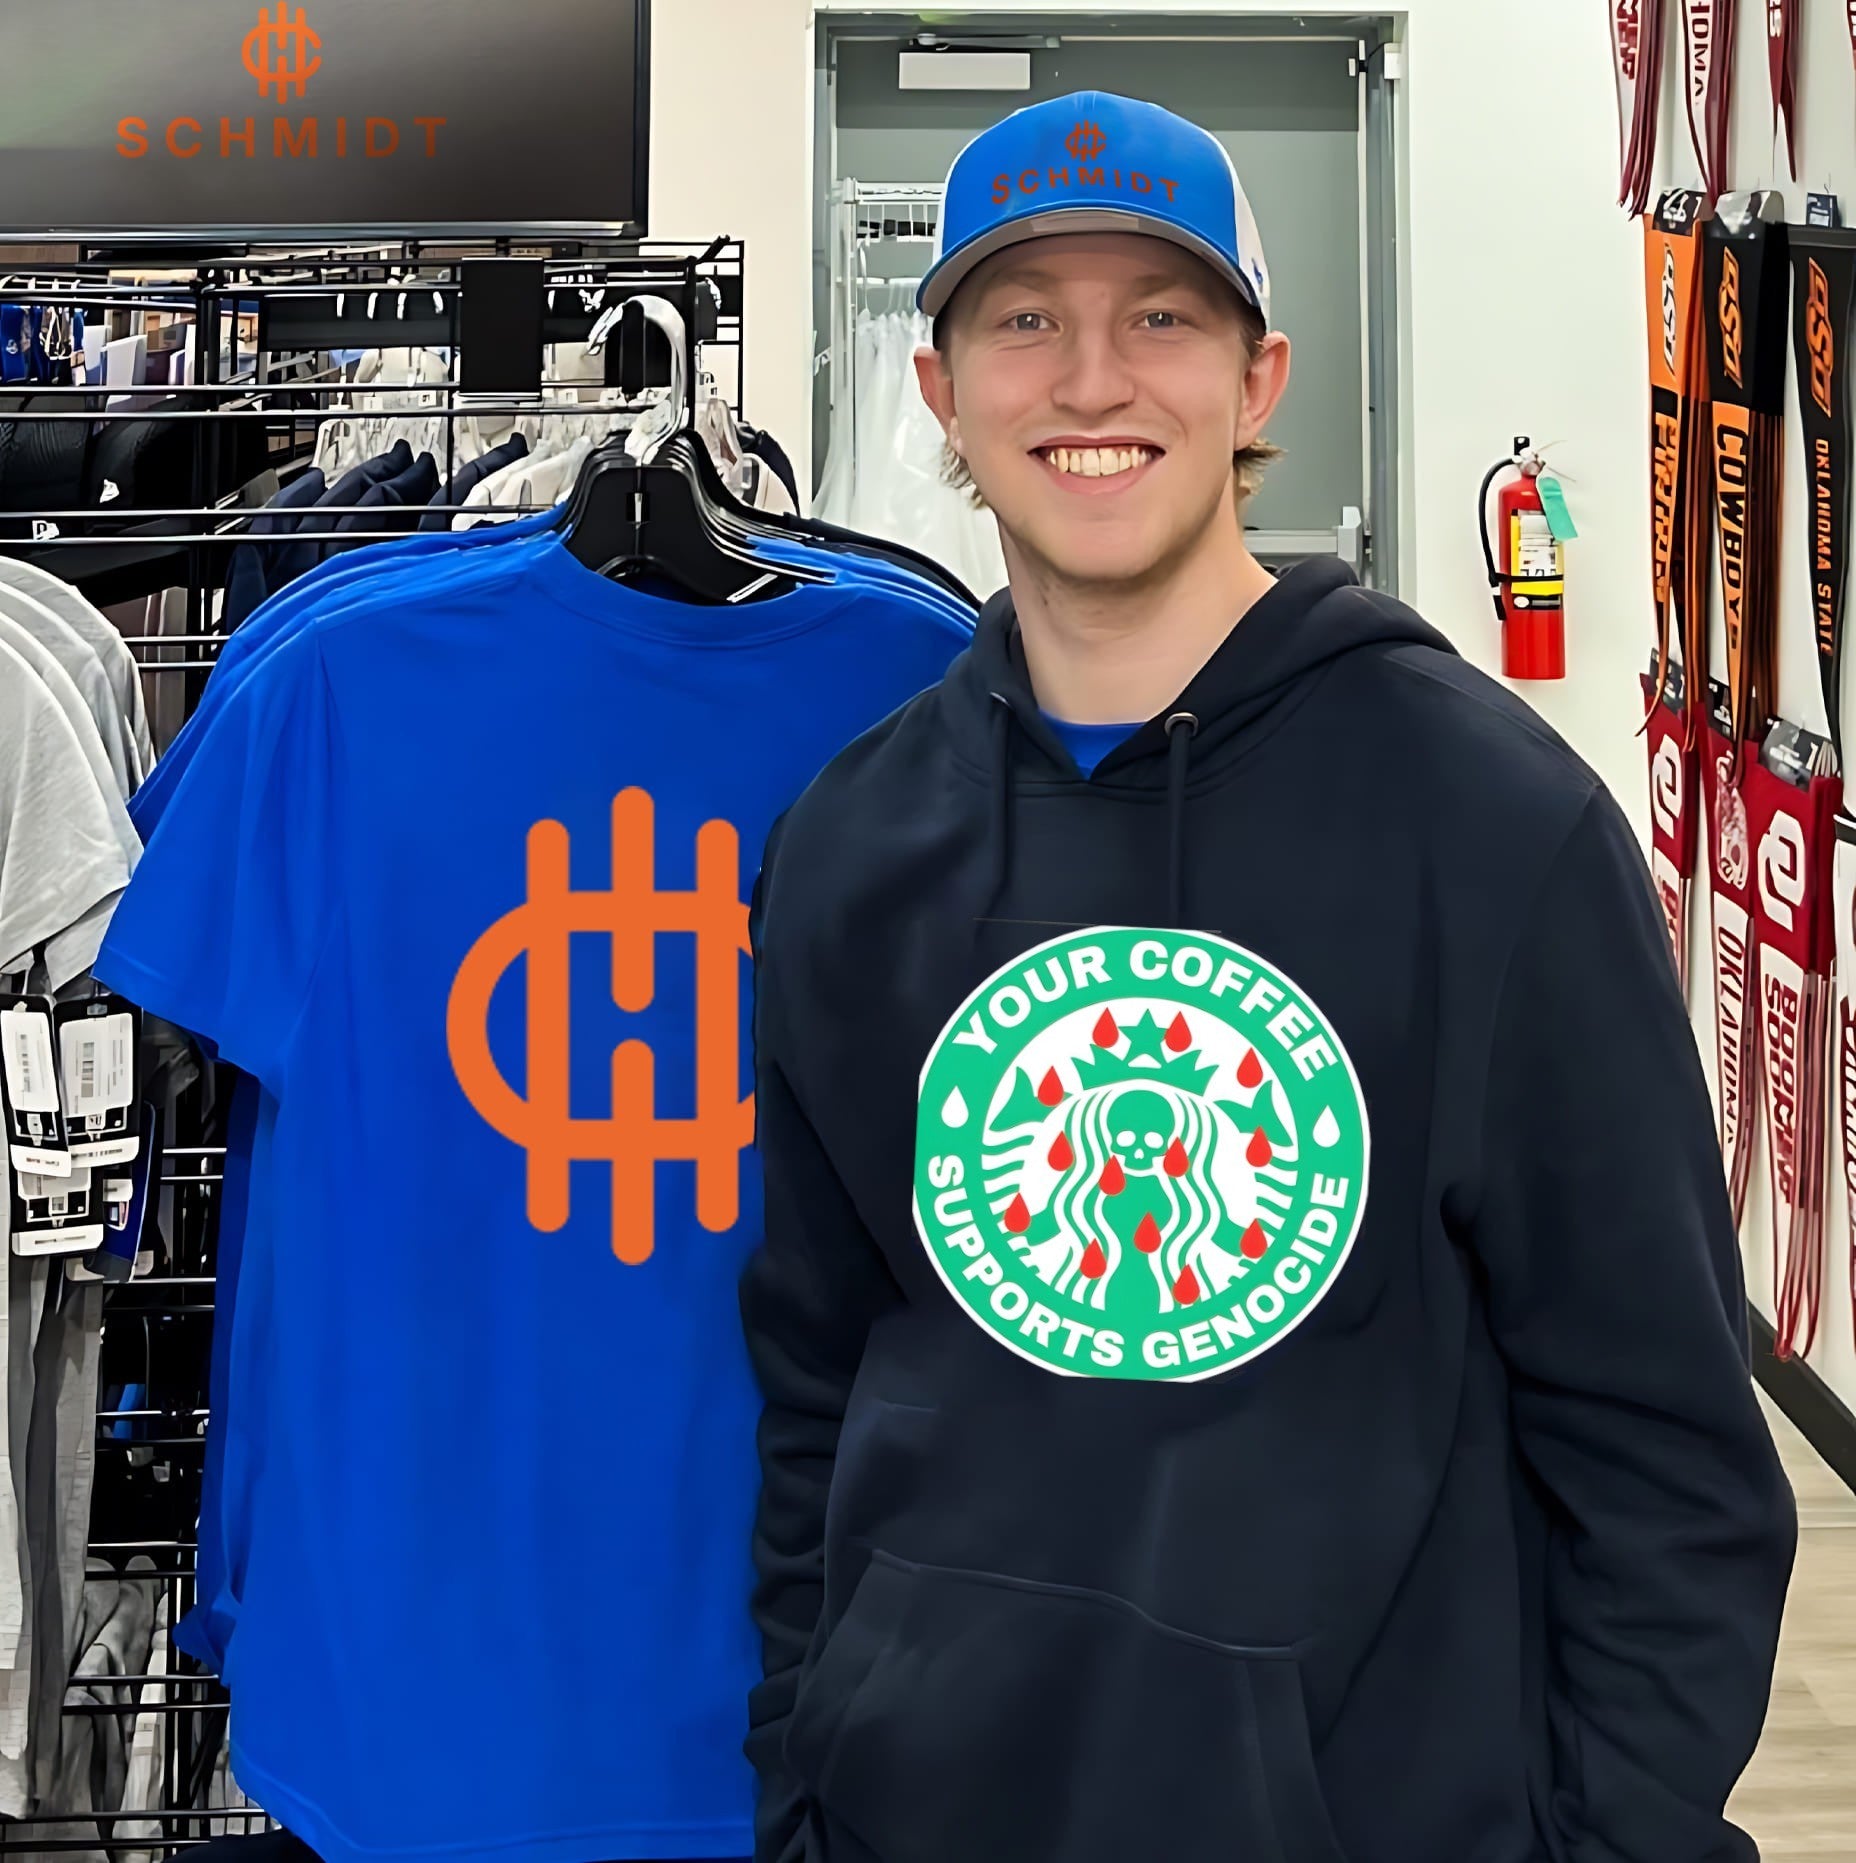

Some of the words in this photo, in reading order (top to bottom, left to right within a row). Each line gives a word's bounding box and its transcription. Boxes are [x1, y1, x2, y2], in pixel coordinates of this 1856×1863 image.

[116, 117, 447, 158] SCHMIDT
[991, 167, 1179, 205] SCHMIDT
[1815, 438, 1832, 570] OKLAHOMA
[951, 944, 1112, 1056] YOUR
[1129, 940, 1339, 1082] COFFEE
[1717, 926, 1746, 1145] OKLAHOMA
[927, 1154, 1125, 1368] SUPPORTS
[1142, 1173, 1349, 1369] GENOCIDE
